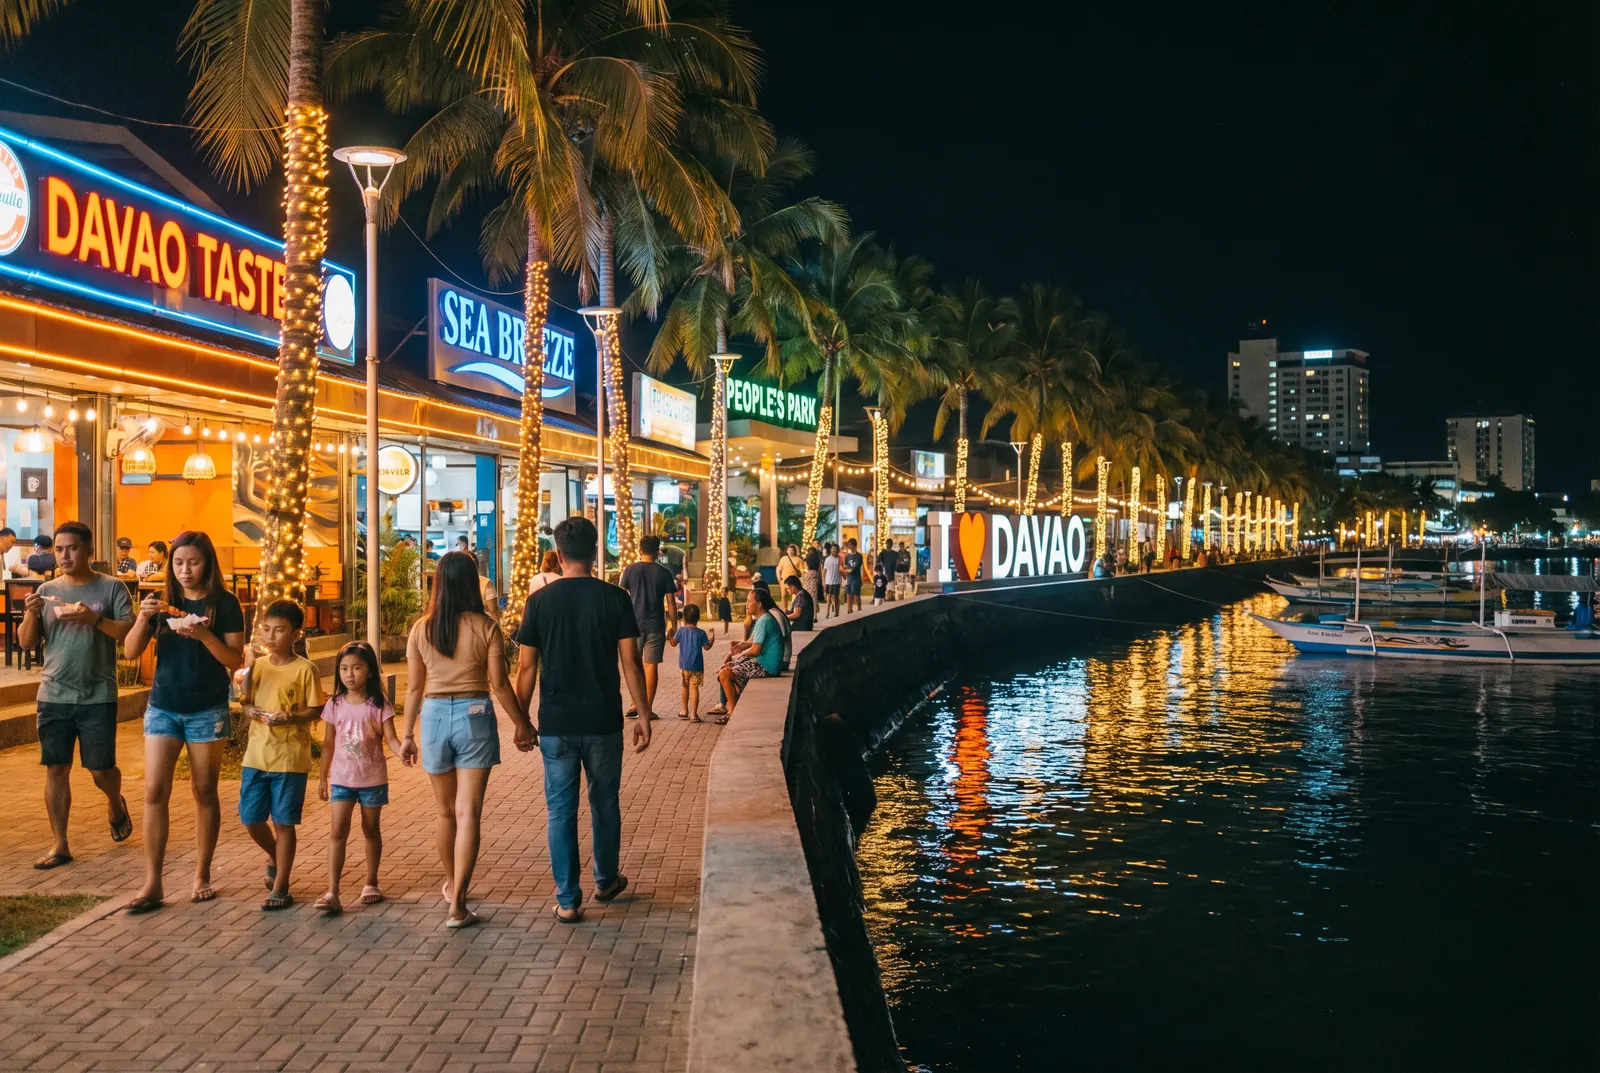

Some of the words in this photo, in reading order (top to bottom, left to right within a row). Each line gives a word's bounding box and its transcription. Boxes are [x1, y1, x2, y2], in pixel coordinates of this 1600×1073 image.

[47, 176, 188, 289] DAVAO
[444, 290, 492, 356] SEA
[498, 310, 575, 382] BREZE
[726, 377, 785, 420] PEOPLE'S
[787, 392, 817, 426] PARK
[992, 514, 1086, 579] DAVAO
